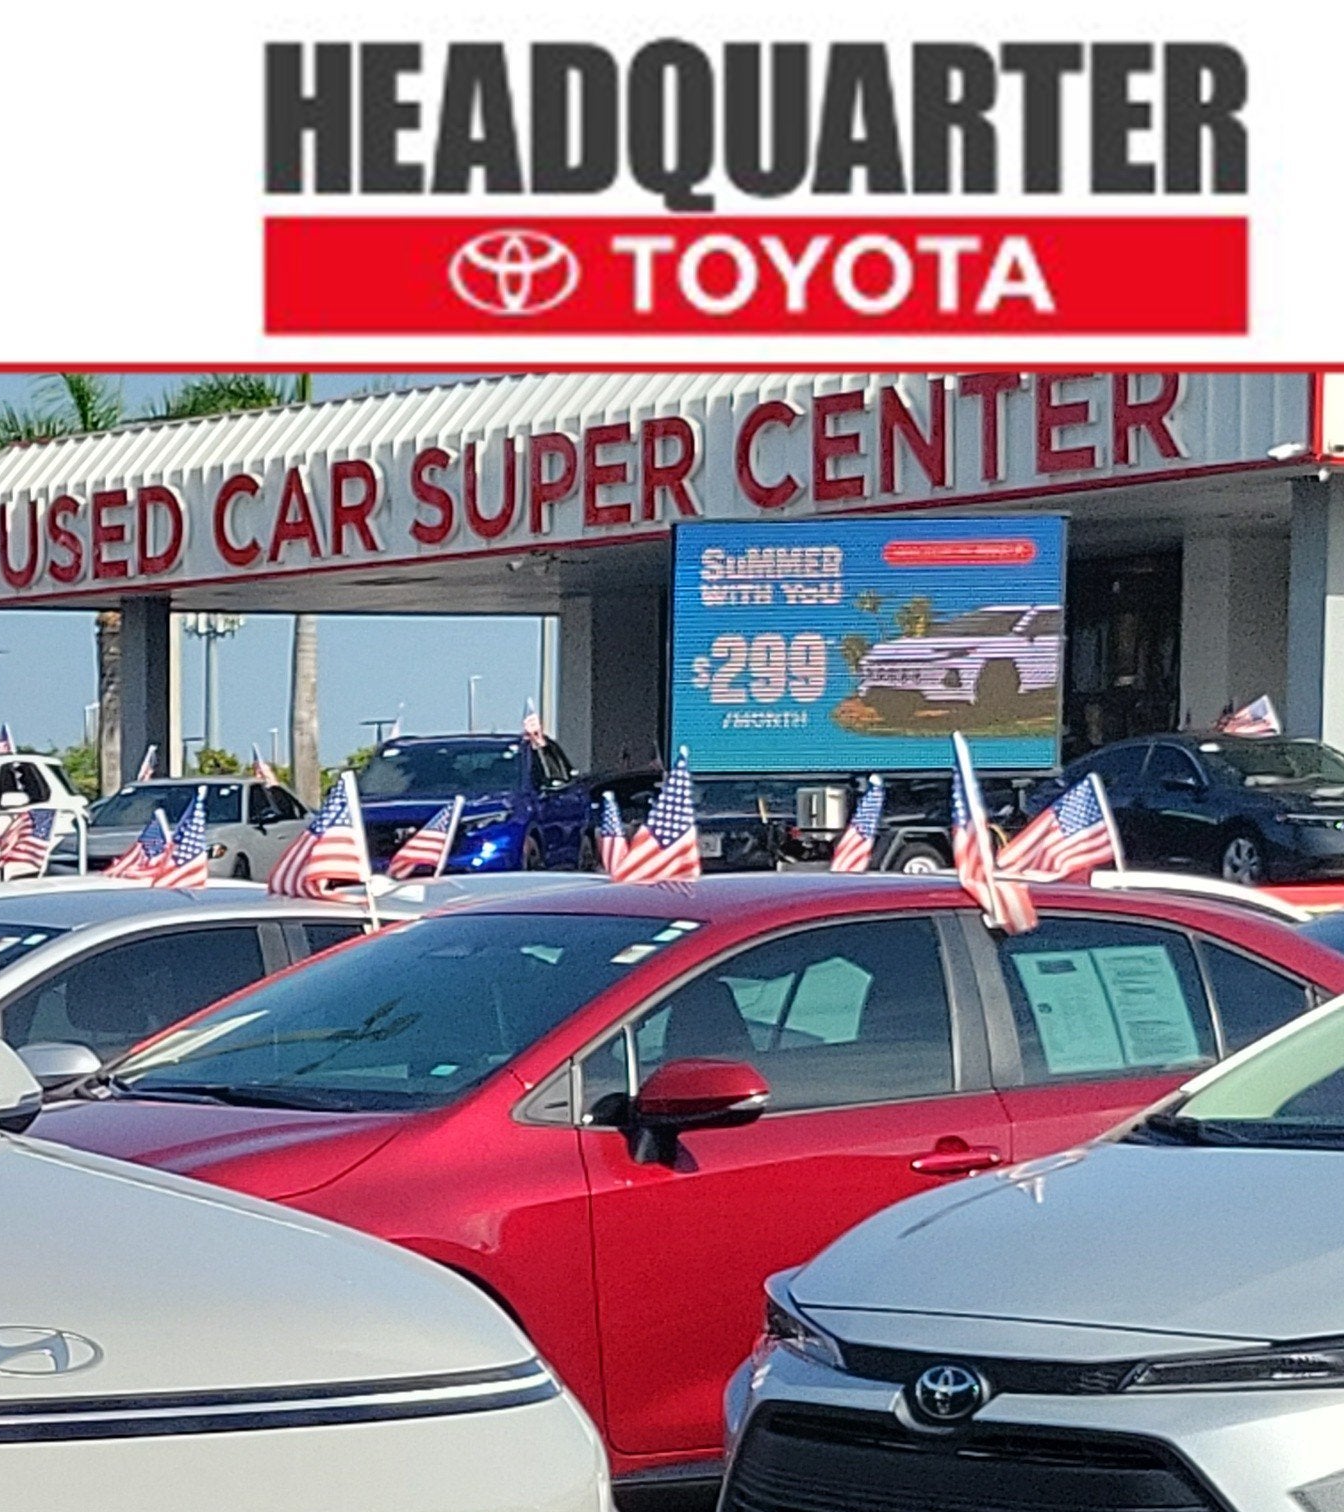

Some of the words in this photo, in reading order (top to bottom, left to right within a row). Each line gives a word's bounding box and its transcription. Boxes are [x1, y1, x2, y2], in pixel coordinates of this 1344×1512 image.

[214, 459, 380, 567] CAR
[410, 416, 699, 544] SUPER
[736, 372, 1181, 508] CENTER
[701, 585, 773, 606] WITH
[691, 633, 827, 704] $299
